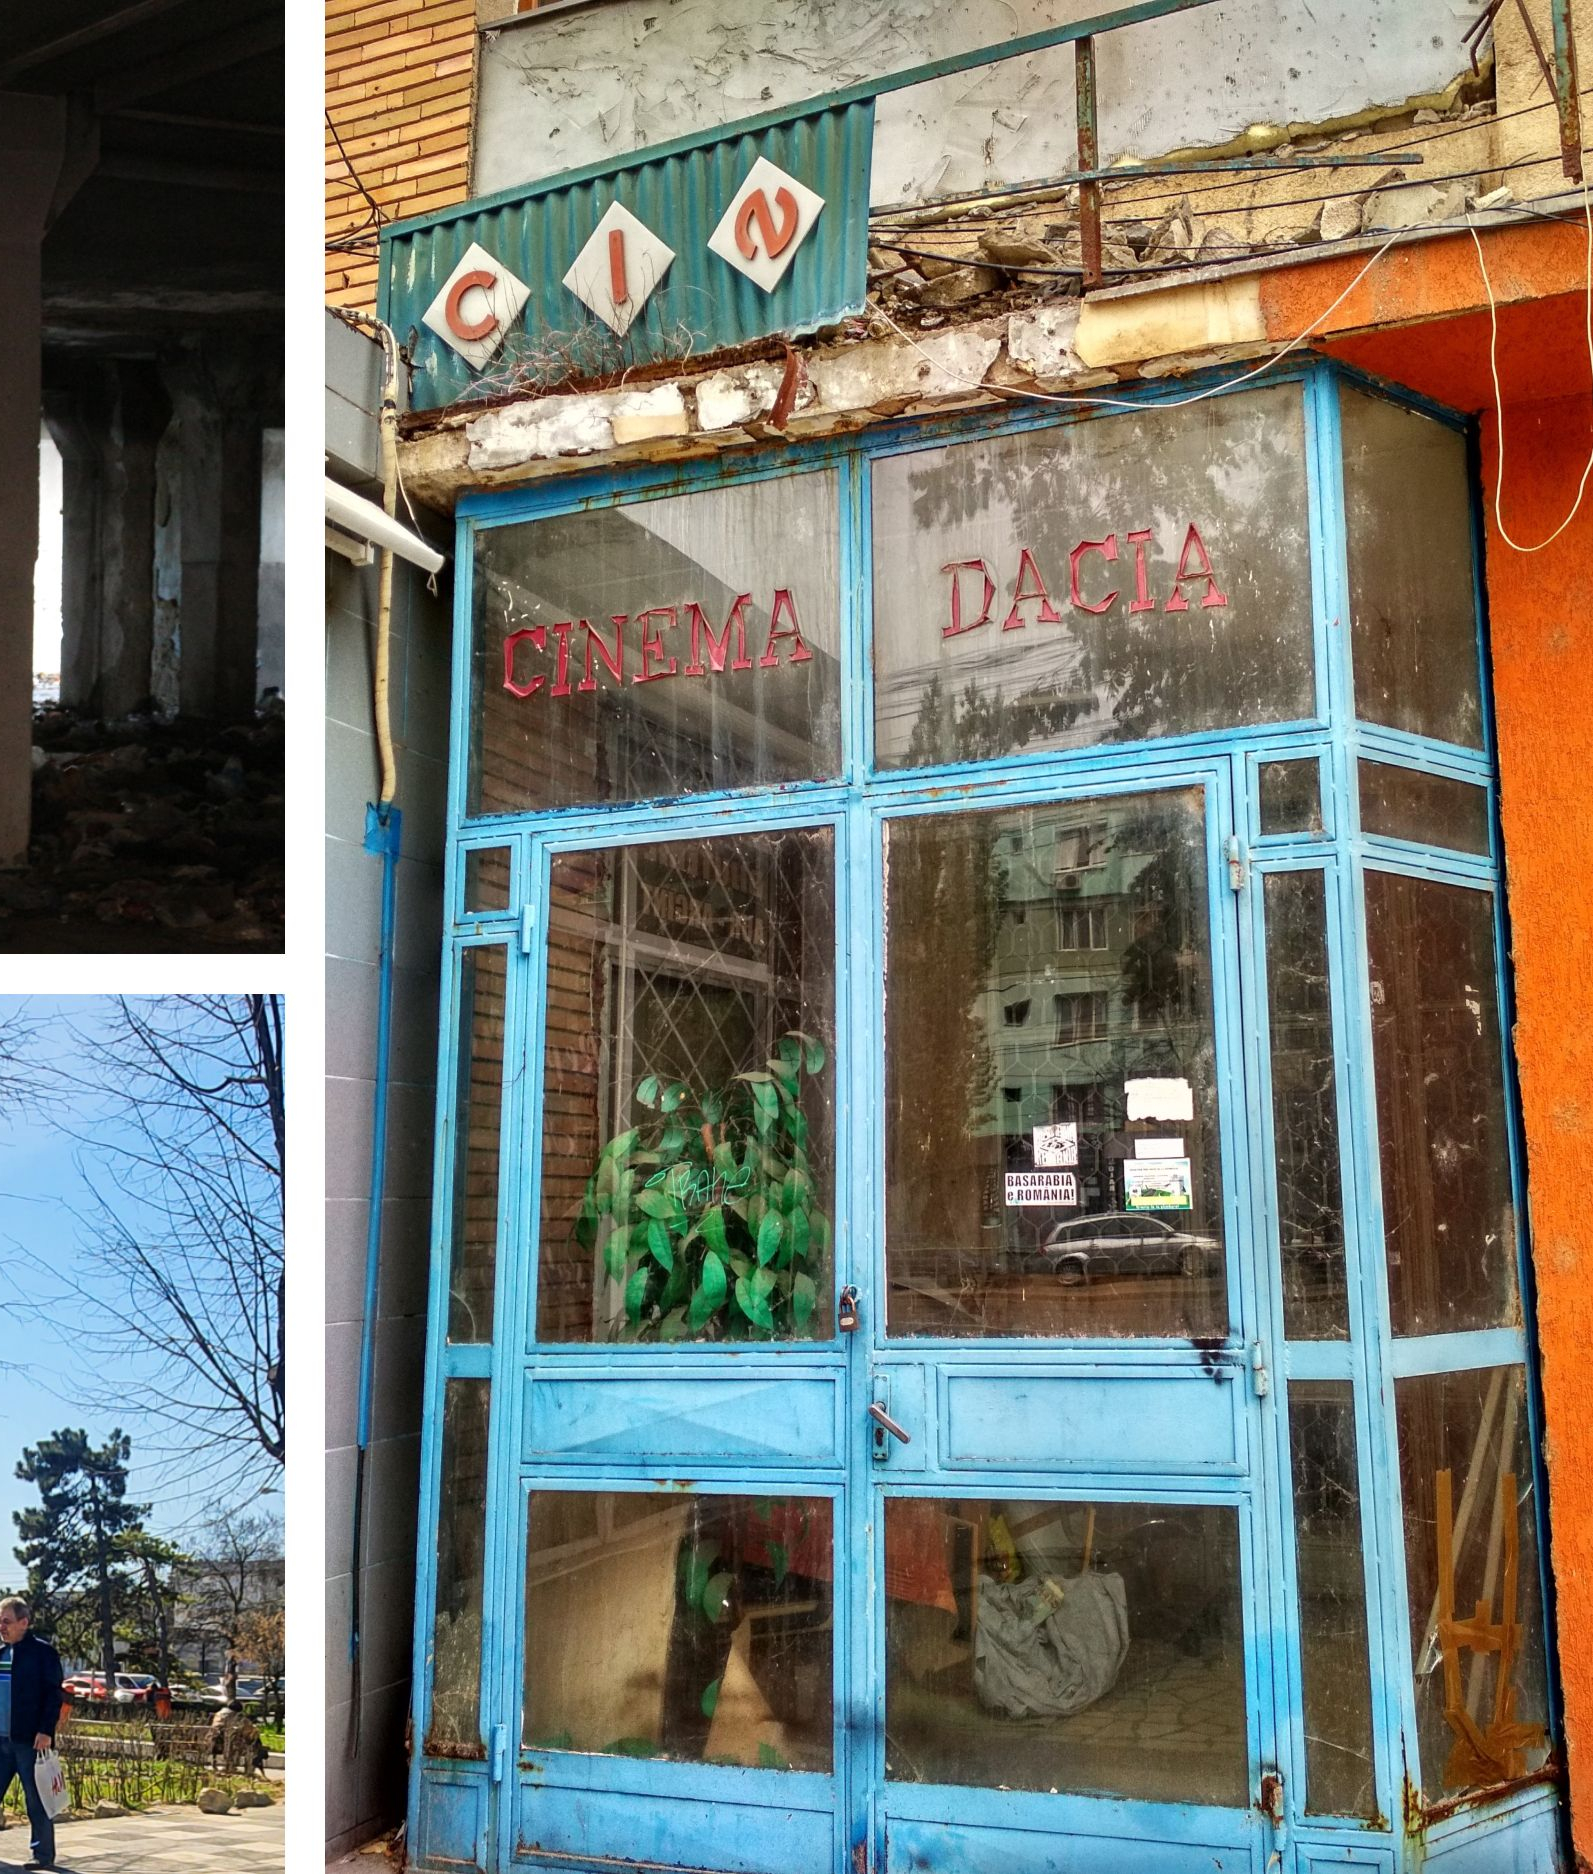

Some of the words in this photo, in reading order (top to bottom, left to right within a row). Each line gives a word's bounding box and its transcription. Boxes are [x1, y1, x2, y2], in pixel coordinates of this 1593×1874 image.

[503, 588, 813, 698] CINEMA
[940, 522, 1229, 639] DACIA
[1008, 1174, 1072, 1187] BASARABIA
[1007, 1190, 1014, 1201] e
